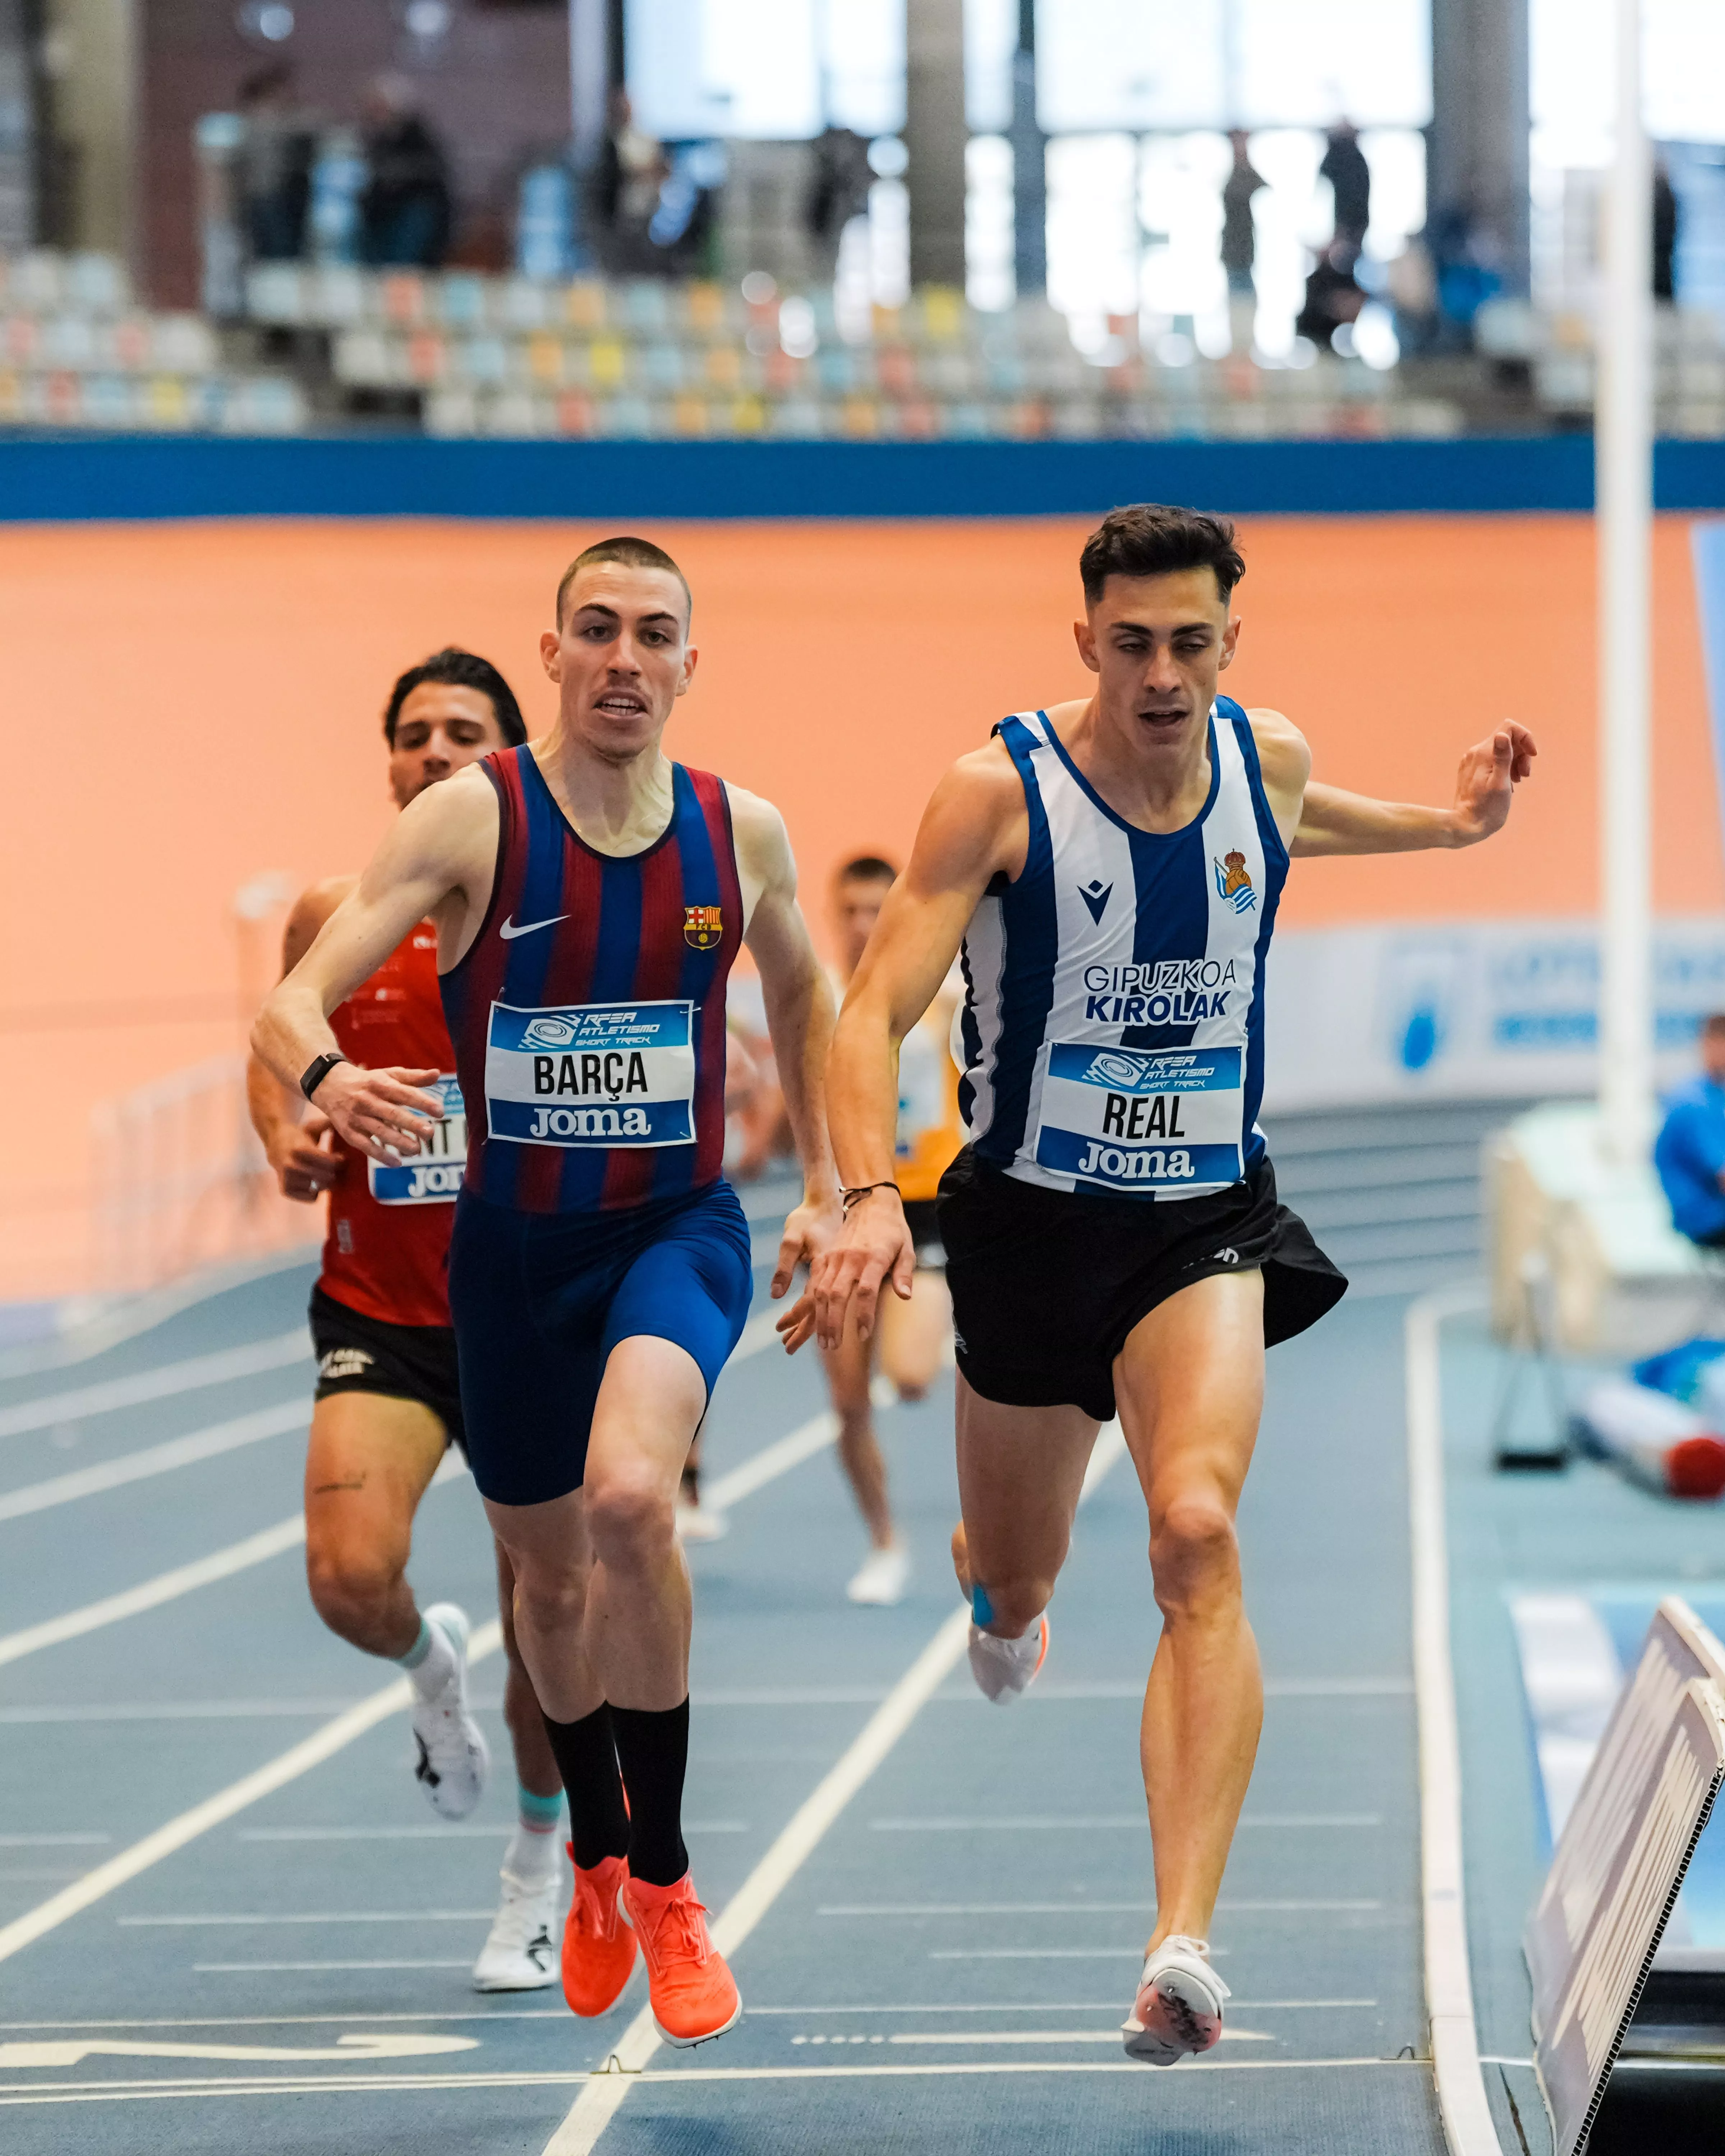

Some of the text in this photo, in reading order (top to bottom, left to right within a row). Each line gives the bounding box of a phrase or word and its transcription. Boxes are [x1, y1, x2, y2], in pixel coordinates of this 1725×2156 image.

[1084, 959, 1236, 992] GIPUZKOA
[583, 1012, 637, 1027] RFEA
[1085, 990, 1231, 1022] KIROLAK
[579, 1024, 660, 1036] ATLETISMO
[534, 1052, 647, 1101] BARÇA
[1144, 1067, 1215, 1080] ATLETISMO
[1150, 1056, 1197, 1070] RFEA
[1139, 1080, 1205, 1089] SHORT TRACK
[530, 1108, 651, 1137] Joma
[1102, 1093, 1185, 1139] REAL
[1078, 1142, 1195, 1179] Joma
